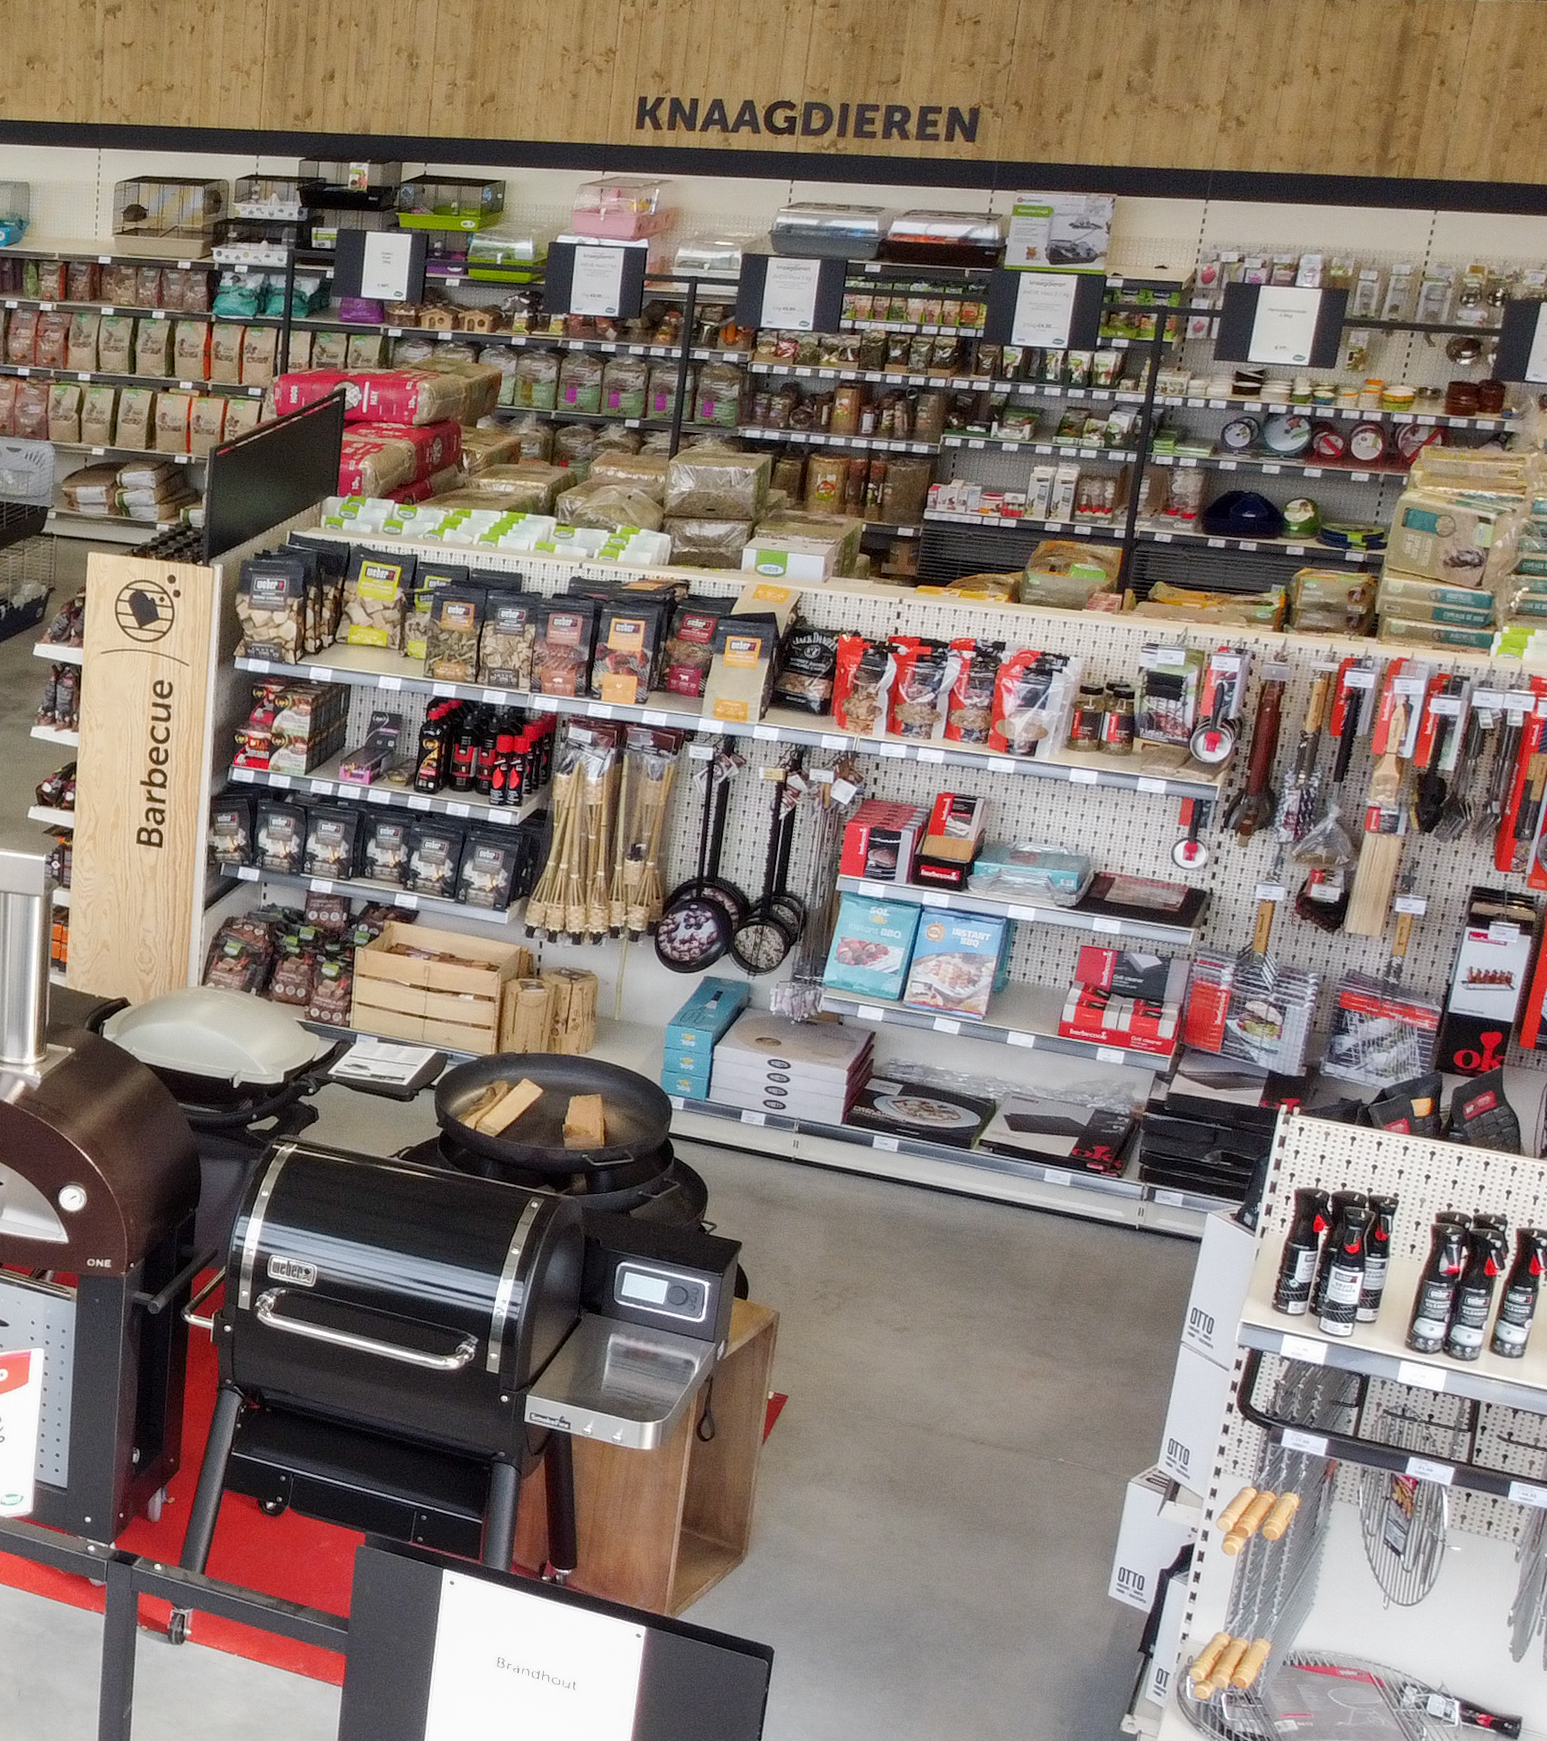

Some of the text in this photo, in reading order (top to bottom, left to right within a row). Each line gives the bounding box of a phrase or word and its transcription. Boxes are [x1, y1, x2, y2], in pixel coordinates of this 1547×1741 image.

[636, 96, 980, 143] KNAAGDIEREN
[366, 567, 389, 579] weber
[793, 634, 812, 645] JACK
[135, 679, 173, 849] Barbecue
[920, 867, 960, 881] barbecook
[880, 928, 902, 940] BBQ
[952, 927, 992, 941] INSTANT
[960, 937, 979, 949] BBQ
[1100, 950, 1113, 986] barbecook
[1069, 1028, 1108, 1041] barbecook
[1454, 1031, 1505, 1072] ok
[86, 1257, 112, 1269] ONE
[270, 1260, 302, 1282] weber
[1190, 1307, 1215, 1336] OTTO
[530, 1411, 571, 1429] SmokeFire
[1167, 1437, 1191, 1466] OTTO
[1118, 1566, 1145, 1591] OTTO
[495, 1656, 579, 1694] Brandhout
